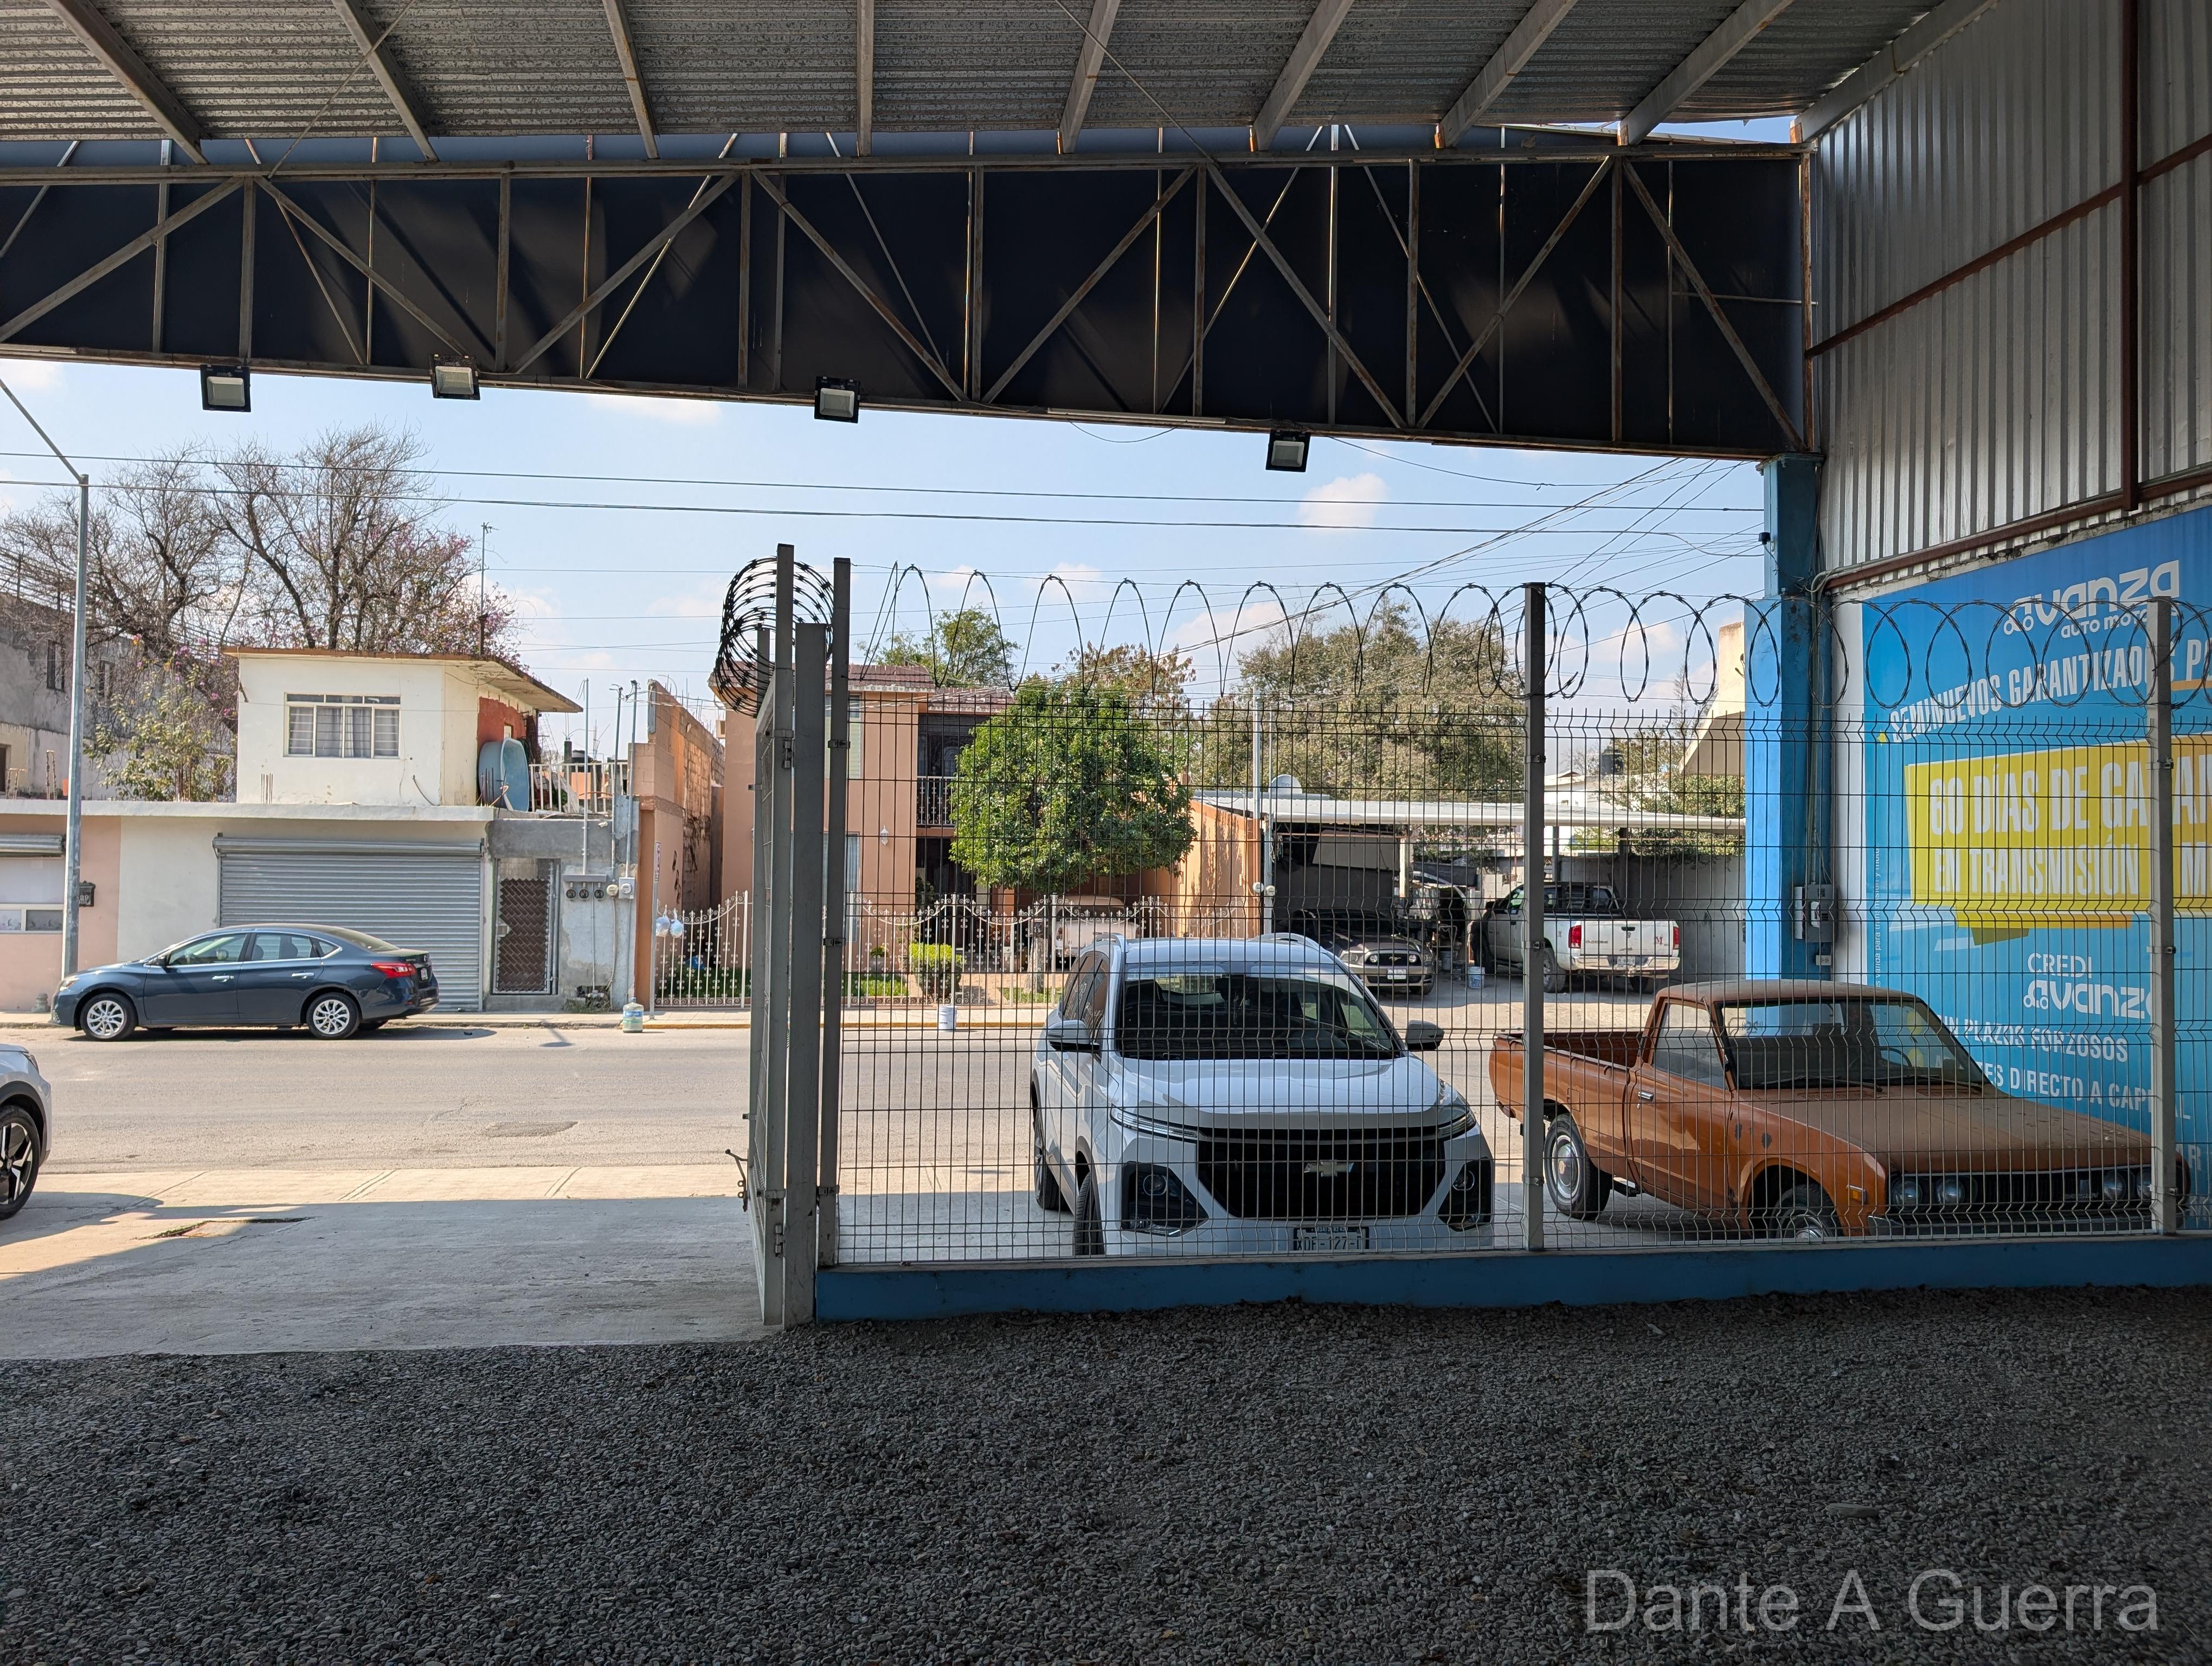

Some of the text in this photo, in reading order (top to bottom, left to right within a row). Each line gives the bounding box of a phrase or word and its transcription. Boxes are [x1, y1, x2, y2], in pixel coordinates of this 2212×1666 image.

[1891, 674, 2002, 745] SEMINUEVOS
[2009, 641, 2175, 708] GARANTIZAD
[1930, 753, 2212, 836] 60 DÍAS DE GAAN
[1934, 849, 1960, 893] EN
[1969, 835, 2139, 895] TRANSMISIÓN
[2028, 952, 2092, 978] CREDI
[2023, 979, 2151, 1019] avanz
[1964, 1018, 2025, 1048] PLAZOS
[2031, 1027, 2129, 1063] FORZOSOS
[2010, 1067, 2085, 1102] DIRECTO
[2089, 1080, 2102, 1105] A
